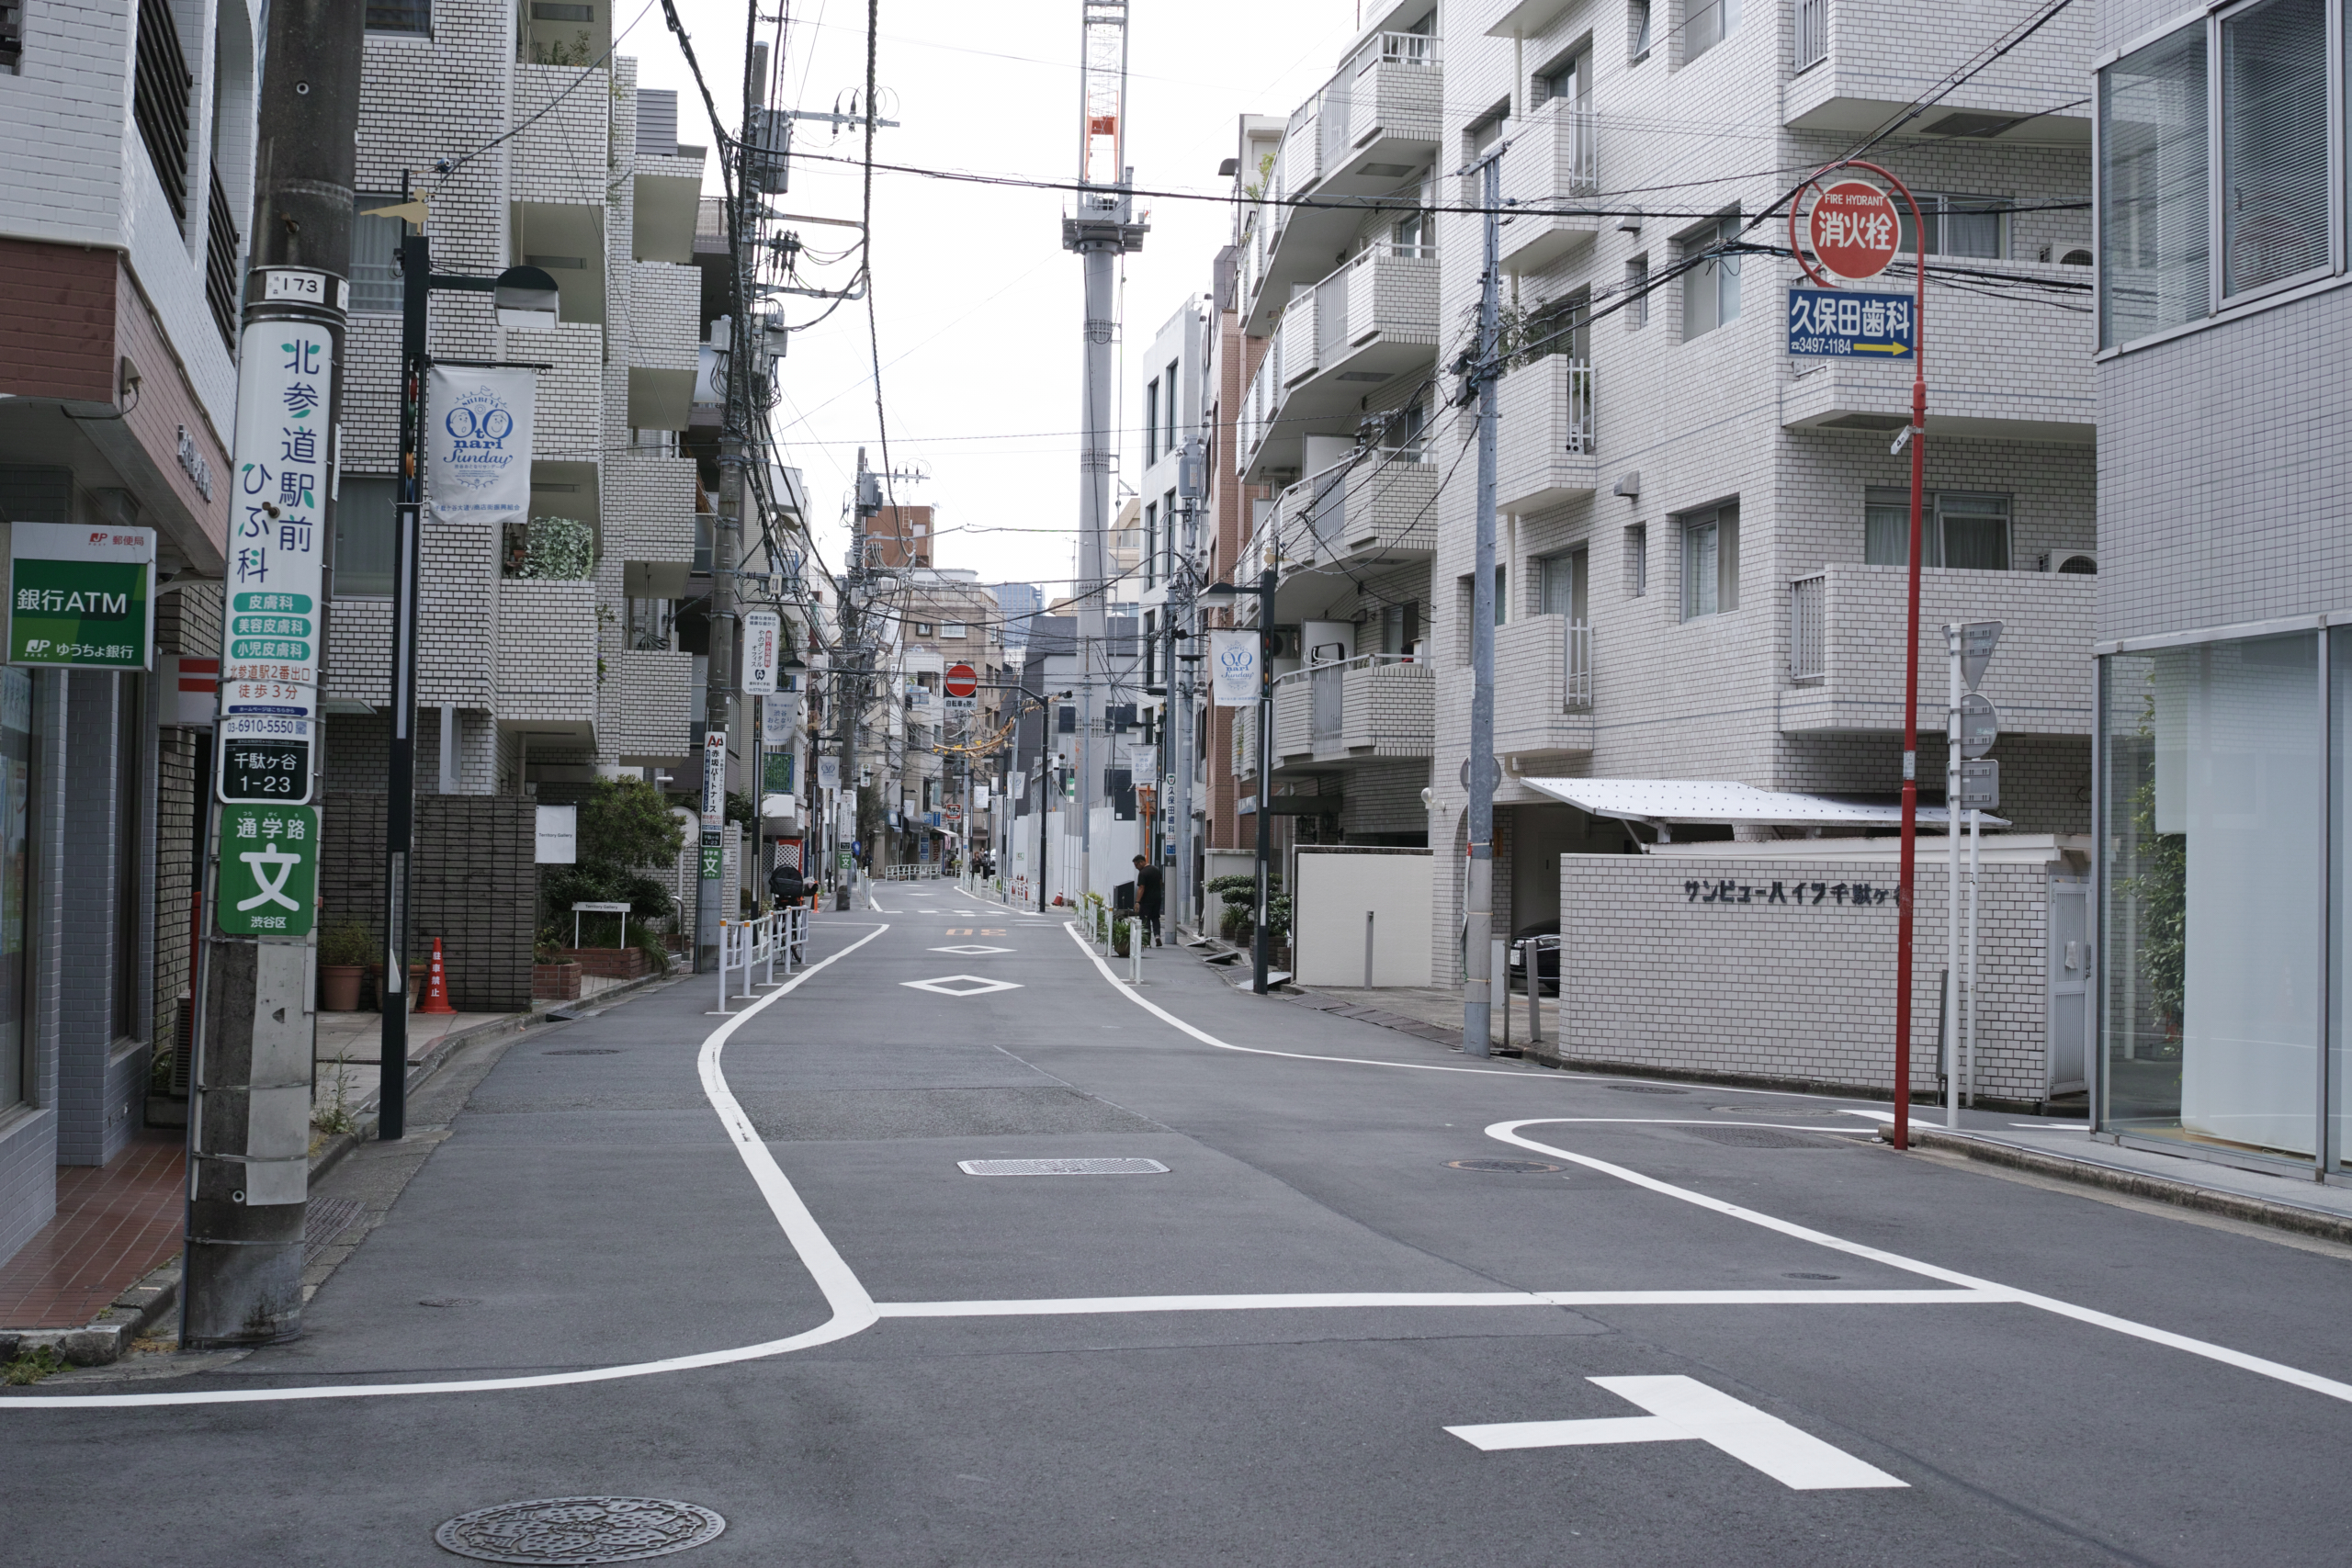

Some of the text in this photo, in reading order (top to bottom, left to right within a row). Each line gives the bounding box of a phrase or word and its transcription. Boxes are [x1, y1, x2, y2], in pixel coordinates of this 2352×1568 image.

[1825, 194, 1883, 207] FIRE HYDRANT
[1818, 210, 1893, 250] 消火栓
[284, 277, 317, 293] 173
[1791, 296, 1910, 339] 久保田歯科
[1799, 336, 1851, 354] 3497-1184
[461, 396, 499, 409] SHIBUYA
[277, 339, 321, 553] 北参道駅前
[443, 449, 514, 468] Sunday
[237, 462, 273, 584] ひふ科
[112, 536, 144, 546] 郵便局
[248, 594, 294, 611] 皮膚科
[238, 618, 304, 635] 美容皮膚科
[56, 643, 134, 659] ゆうちょ銀行
[237, 641, 302, 659] 小児皮膚科
[230, 664, 311, 682] 北参道駅2番出口
[238, 683, 298, 700] 徒歩3分
[227, 719, 294, 734] 03-6910-5550
[234, 752, 298, 771] 千駄ヶ谷
[240, 775, 291, 793] 1-23
[236, 818, 305, 840] 通学路
[703, 857, 718, 873] 文
[236, 842, 301, 912] 文
[1683, 879, 1901, 906] サンビューハイツ千駄ヶ
[250, 915, 287, 929] 渋谷区
[431, 952, 441, 997] 駐車禁止
